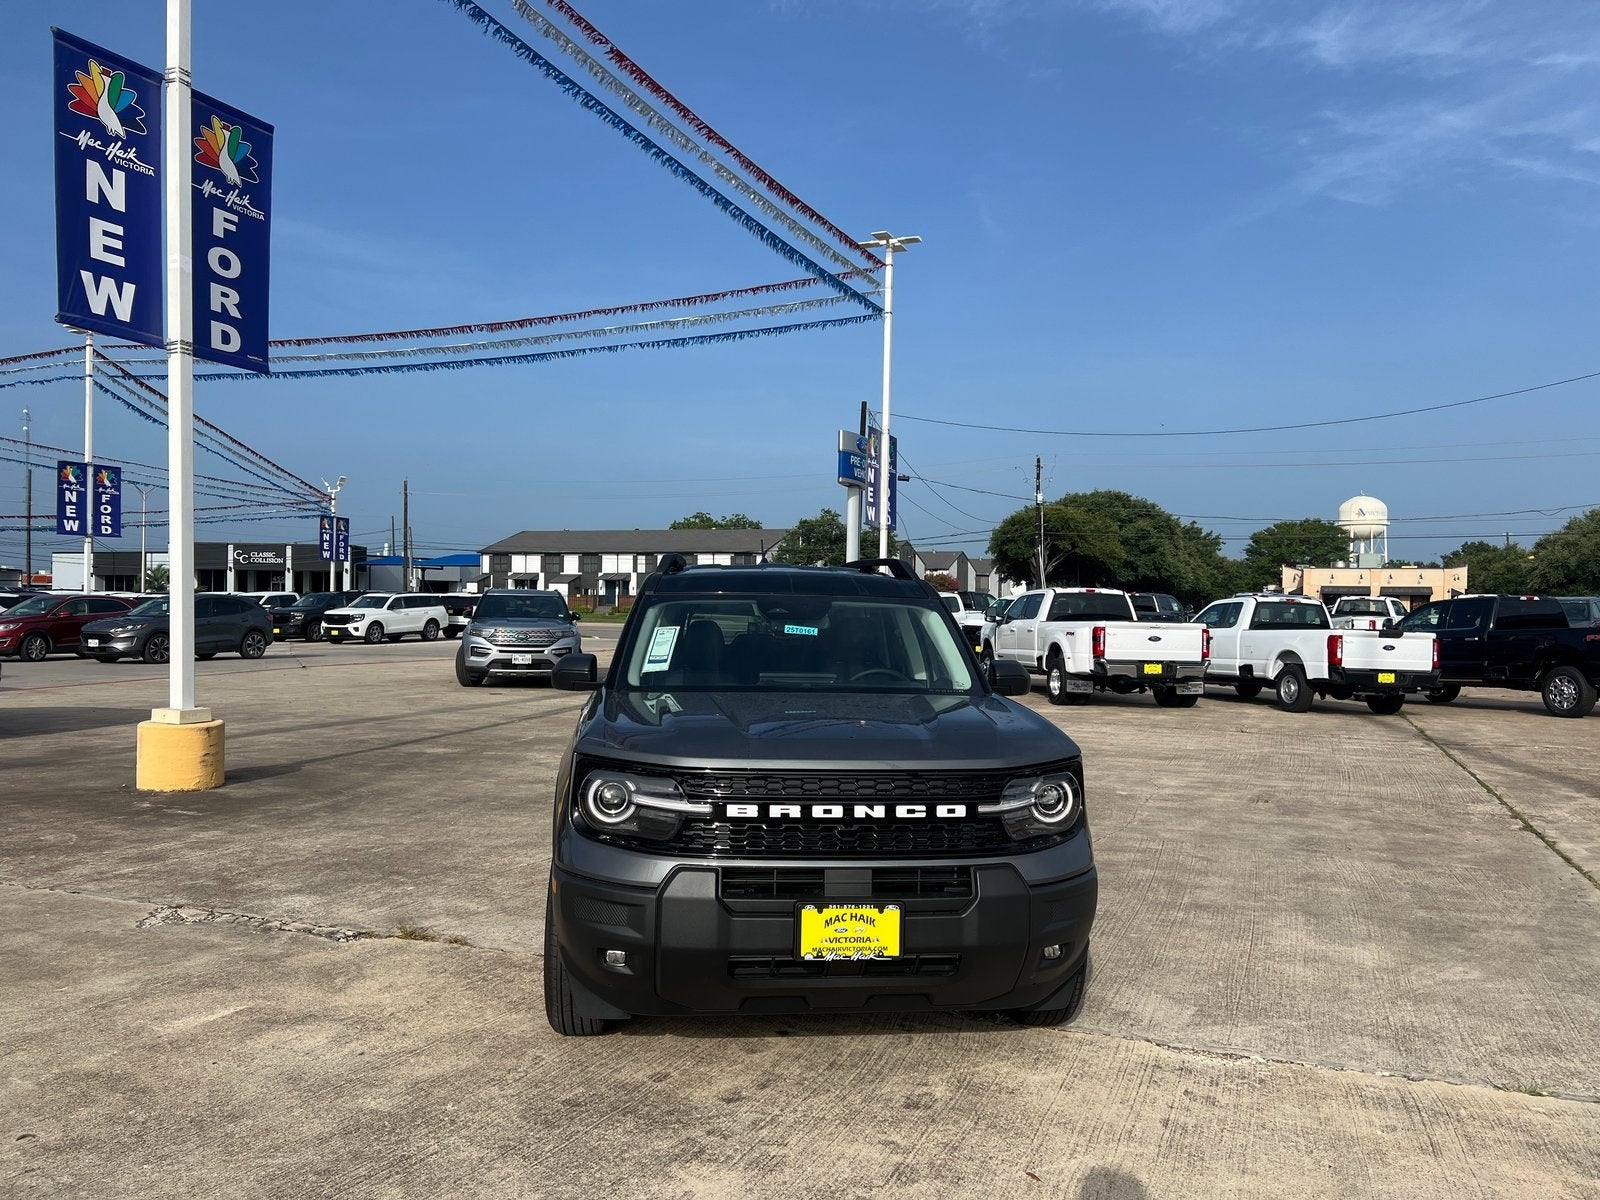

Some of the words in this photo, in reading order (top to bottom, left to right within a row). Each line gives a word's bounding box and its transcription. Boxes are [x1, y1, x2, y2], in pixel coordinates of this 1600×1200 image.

[60, 129, 106, 151] Mac
[105, 141, 155, 169] Haik
[113, 156, 155, 176] VICTORIA
[192, 179, 226, 198] Mac
[225, 189, 265, 214] Haik
[232, 203, 265, 220] VICTORIA
[80, 158, 136, 323] NEW
[207, 206, 242, 353] FORD
[866, 467, 876, 522] NEW
[63, 490, 79, 532] NEW
[100, 494, 112, 535] FORD
[322, 533, 331, 559] NEW
[726, 804, 966, 818] BRONCO
[824, 912, 848, 929] MAC
[849, 912, 876, 928] HAIK
[811, 945, 888, 954] MACHAIKVICTORIA.COM
[828, 936, 872, 944] VICTORIA
[814, 950, 851, 961] Mac
[850, 950, 892, 961] Haik
